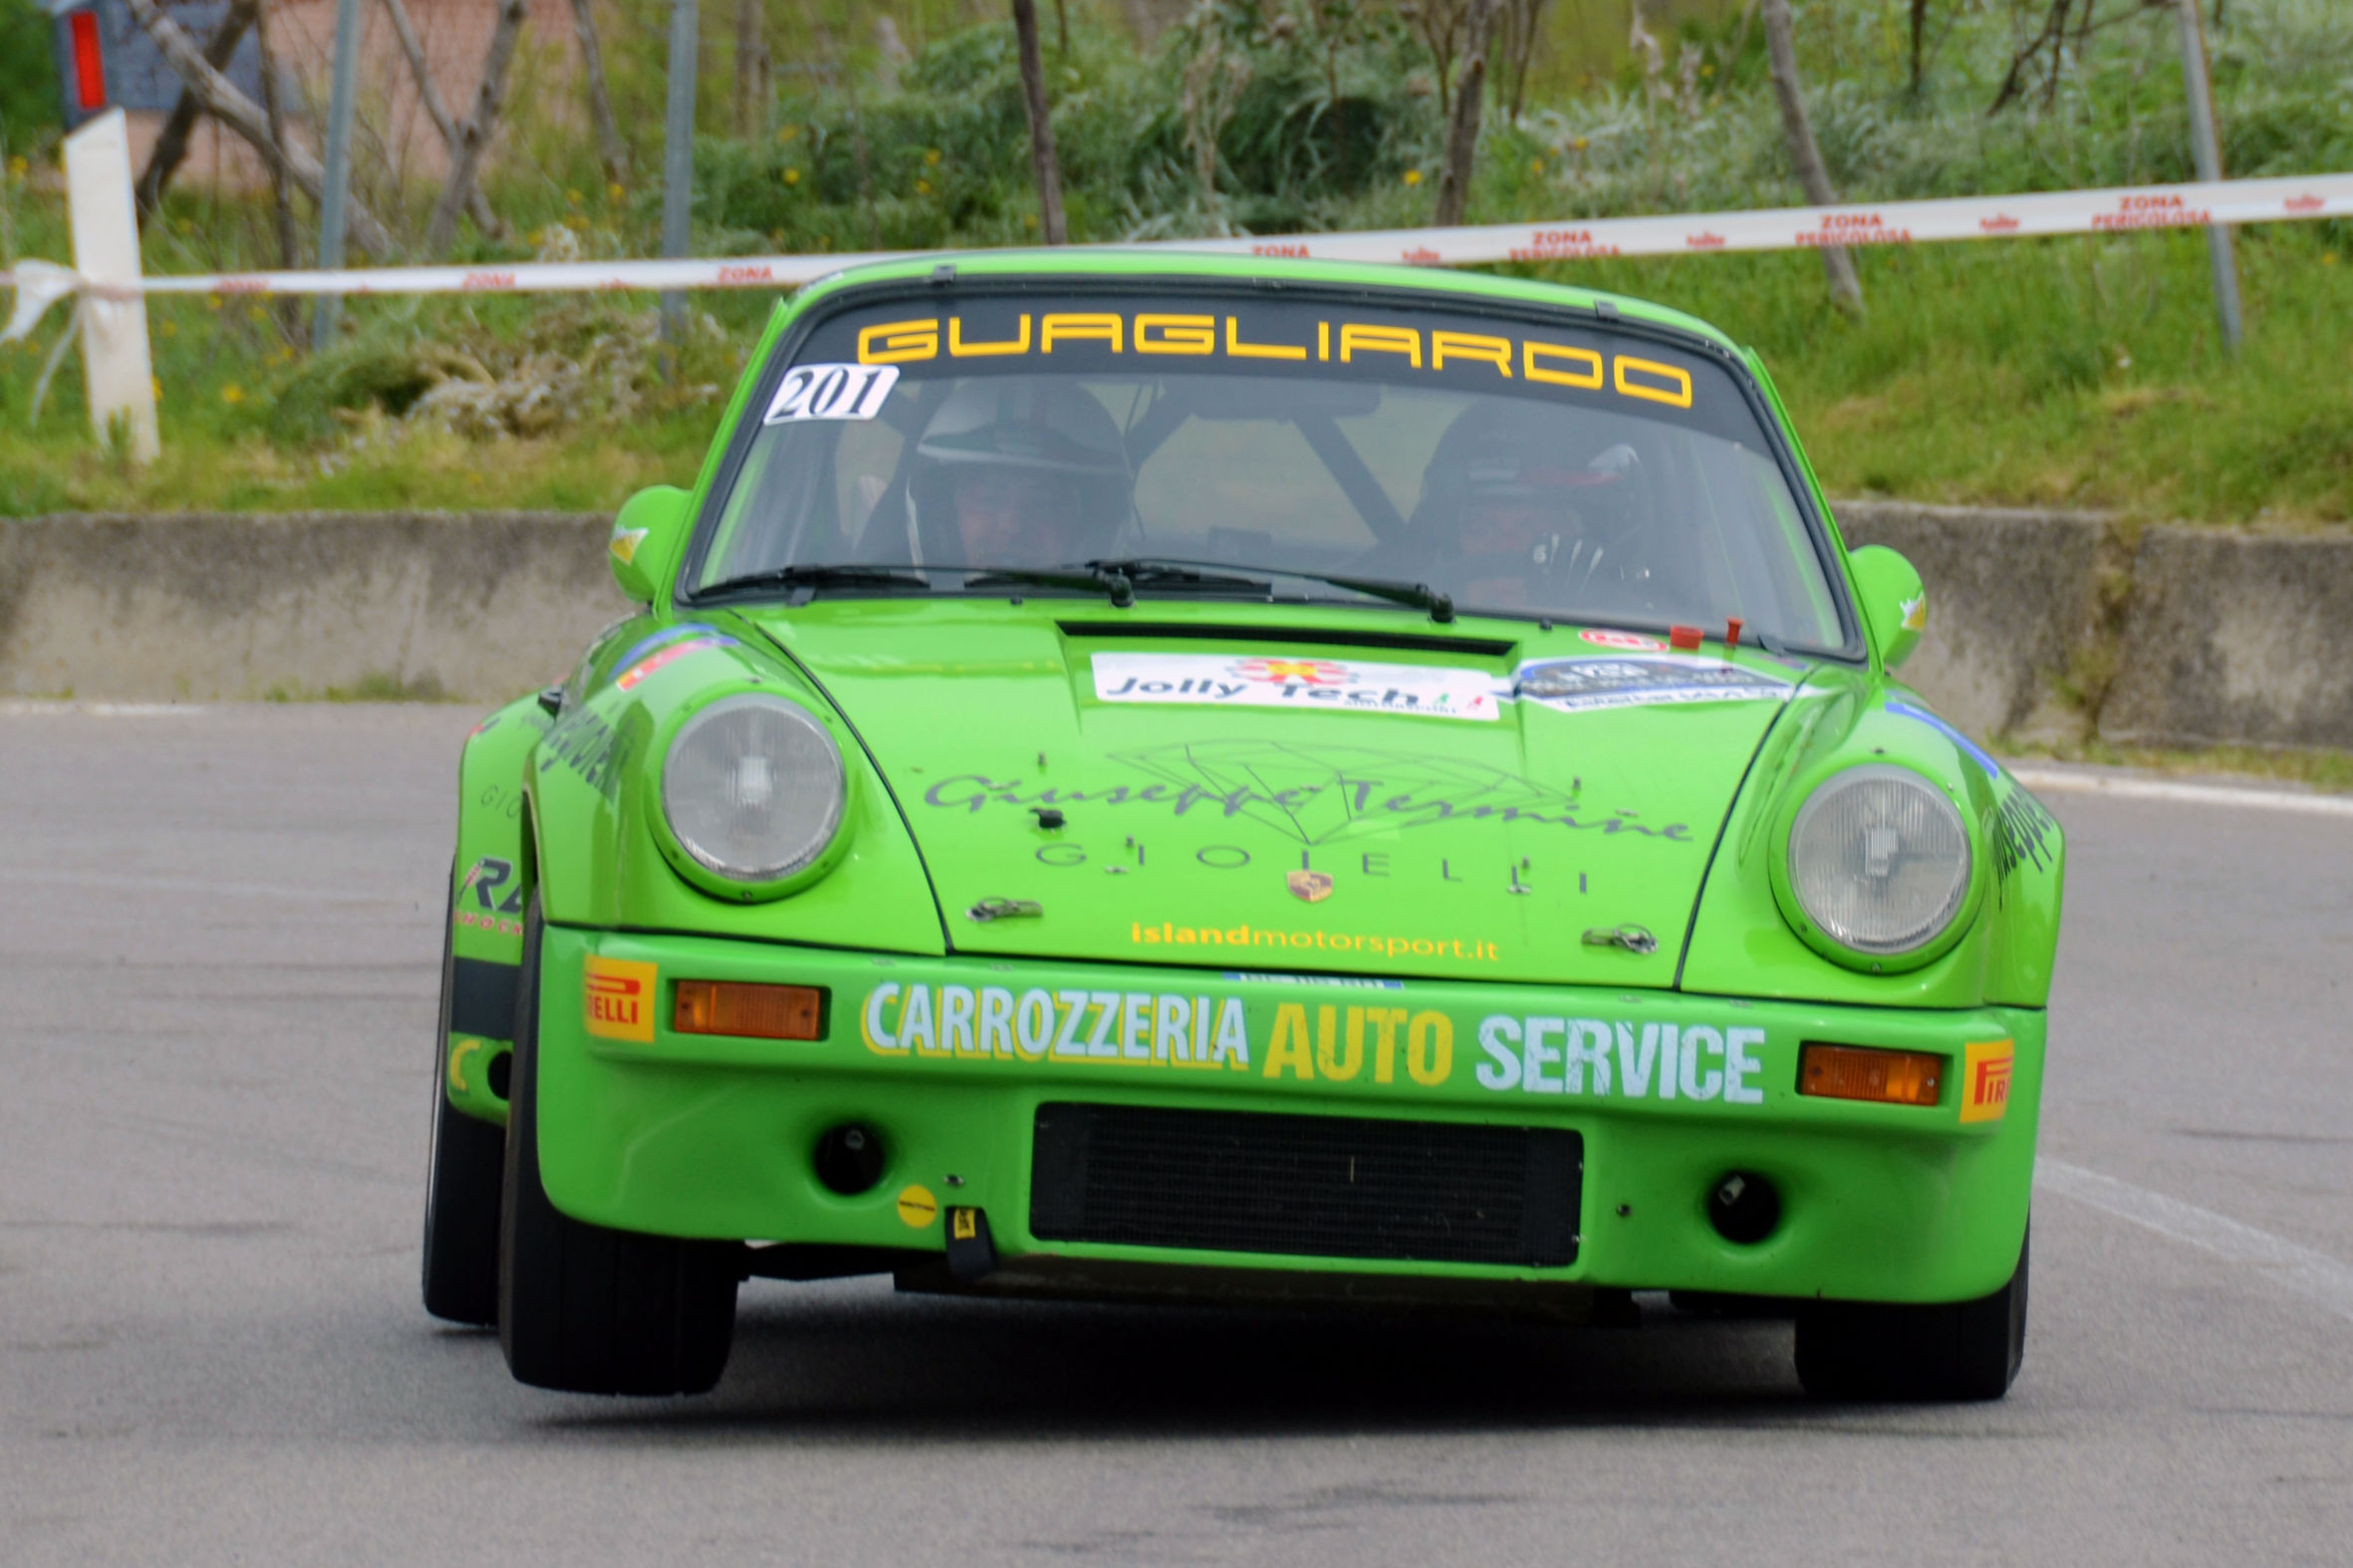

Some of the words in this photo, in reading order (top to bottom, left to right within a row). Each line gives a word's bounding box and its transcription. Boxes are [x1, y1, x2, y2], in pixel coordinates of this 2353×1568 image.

[2119, 194, 2184, 209] ZONA
[1532, 229, 1592, 245] ZONA
[1795, 228, 1912, 246] PERICOLOSA
[1821, 213, 1882, 228] ZONA
[718, 265, 773, 283] ZONA
[858, 312, 1693, 408] GUAGLIARDO
[771, 366, 884, 420] 201
[1107, 676, 1247, 697] Jolly
[1279, 682, 1420, 705] Tech
[923, 774, 1304, 817] Giuseppe
[1036, 842, 1587, 894] GIOIELLI
[1132, 921, 1500, 961] islandmotorsport.it
[860, 981, 1250, 1071] CARROZZERIA
[1262, 1002, 1454, 1087] AUTO
[1475, 1014, 1765, 1105] SERVICE
